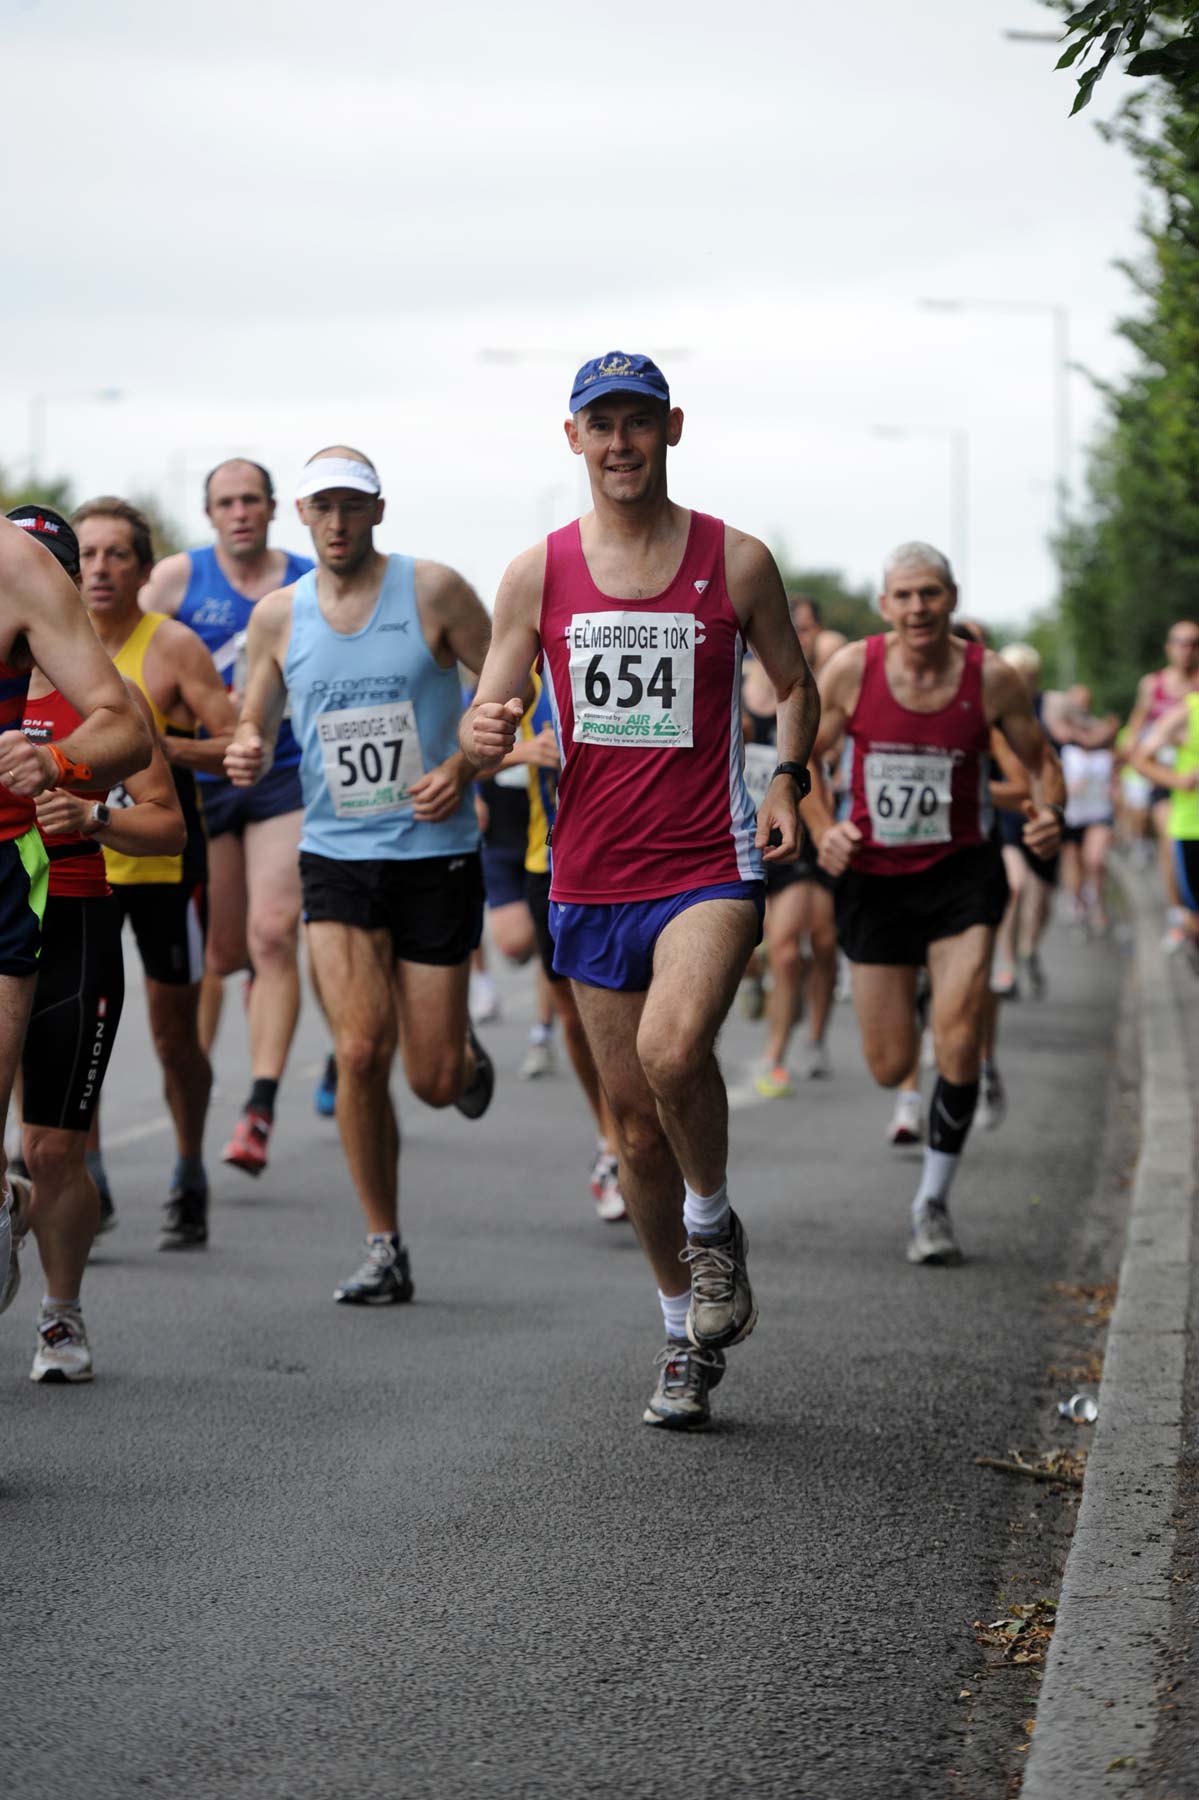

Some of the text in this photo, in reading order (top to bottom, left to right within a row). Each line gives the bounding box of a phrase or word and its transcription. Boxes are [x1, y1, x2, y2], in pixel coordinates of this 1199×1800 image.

[574, 626, 658, 649] ELMBRIDGE
[663, 627, 689, 650] 10K
[584, 654, 677, 710] 654
[582, 722, 650, 736] PRODUCTS
[626, 714, 651, 724] AIR
[337, 739, 404, 788] 507
[877, 785, 939, 819] 670
[79, 1022, 105, 1110] FUSION
